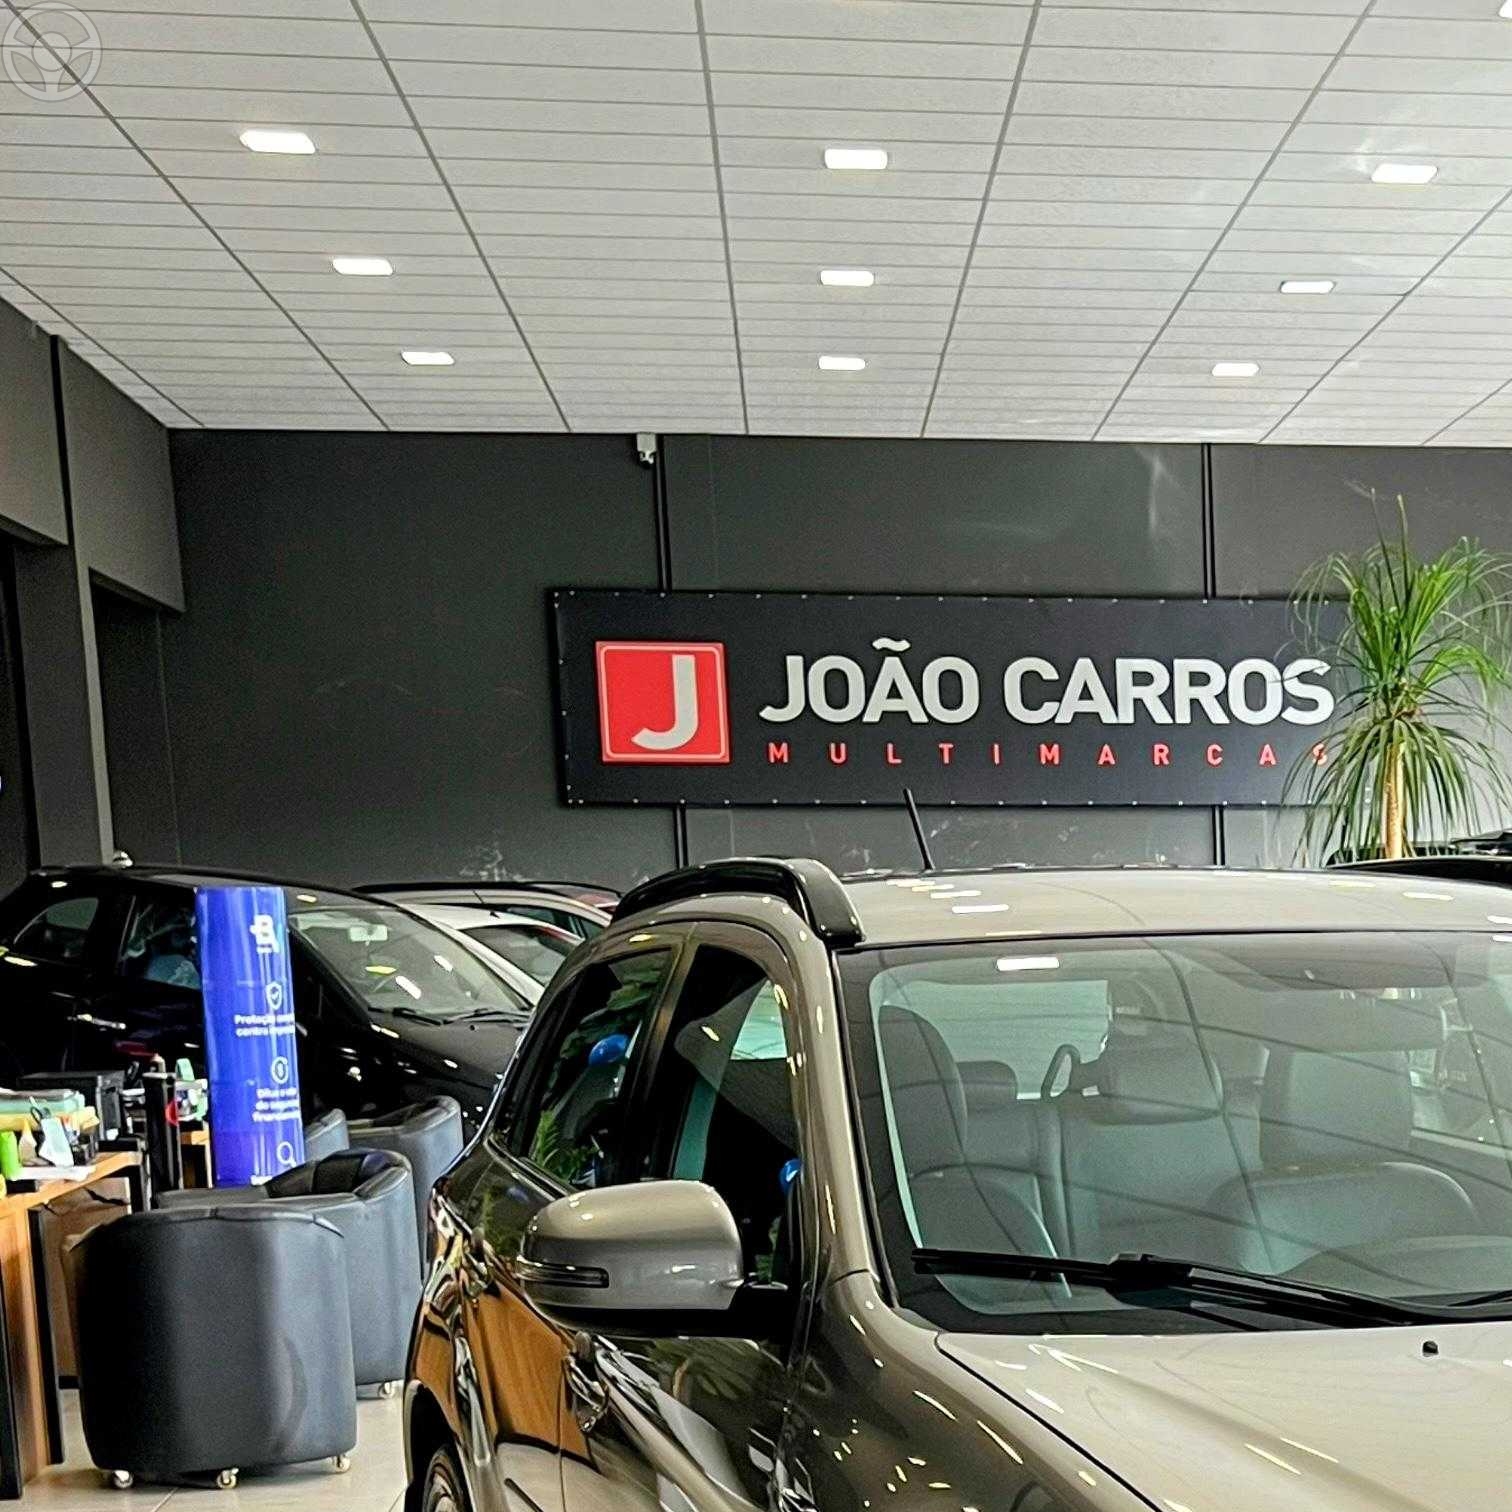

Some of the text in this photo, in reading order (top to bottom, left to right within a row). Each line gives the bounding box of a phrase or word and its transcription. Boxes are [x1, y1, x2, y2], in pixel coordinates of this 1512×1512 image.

[630, 654, 698, 750] J
[758, 637, 1335, 726] JOÃO CARROS
[768, 741, 1329, 767] MULTIMARCAS
